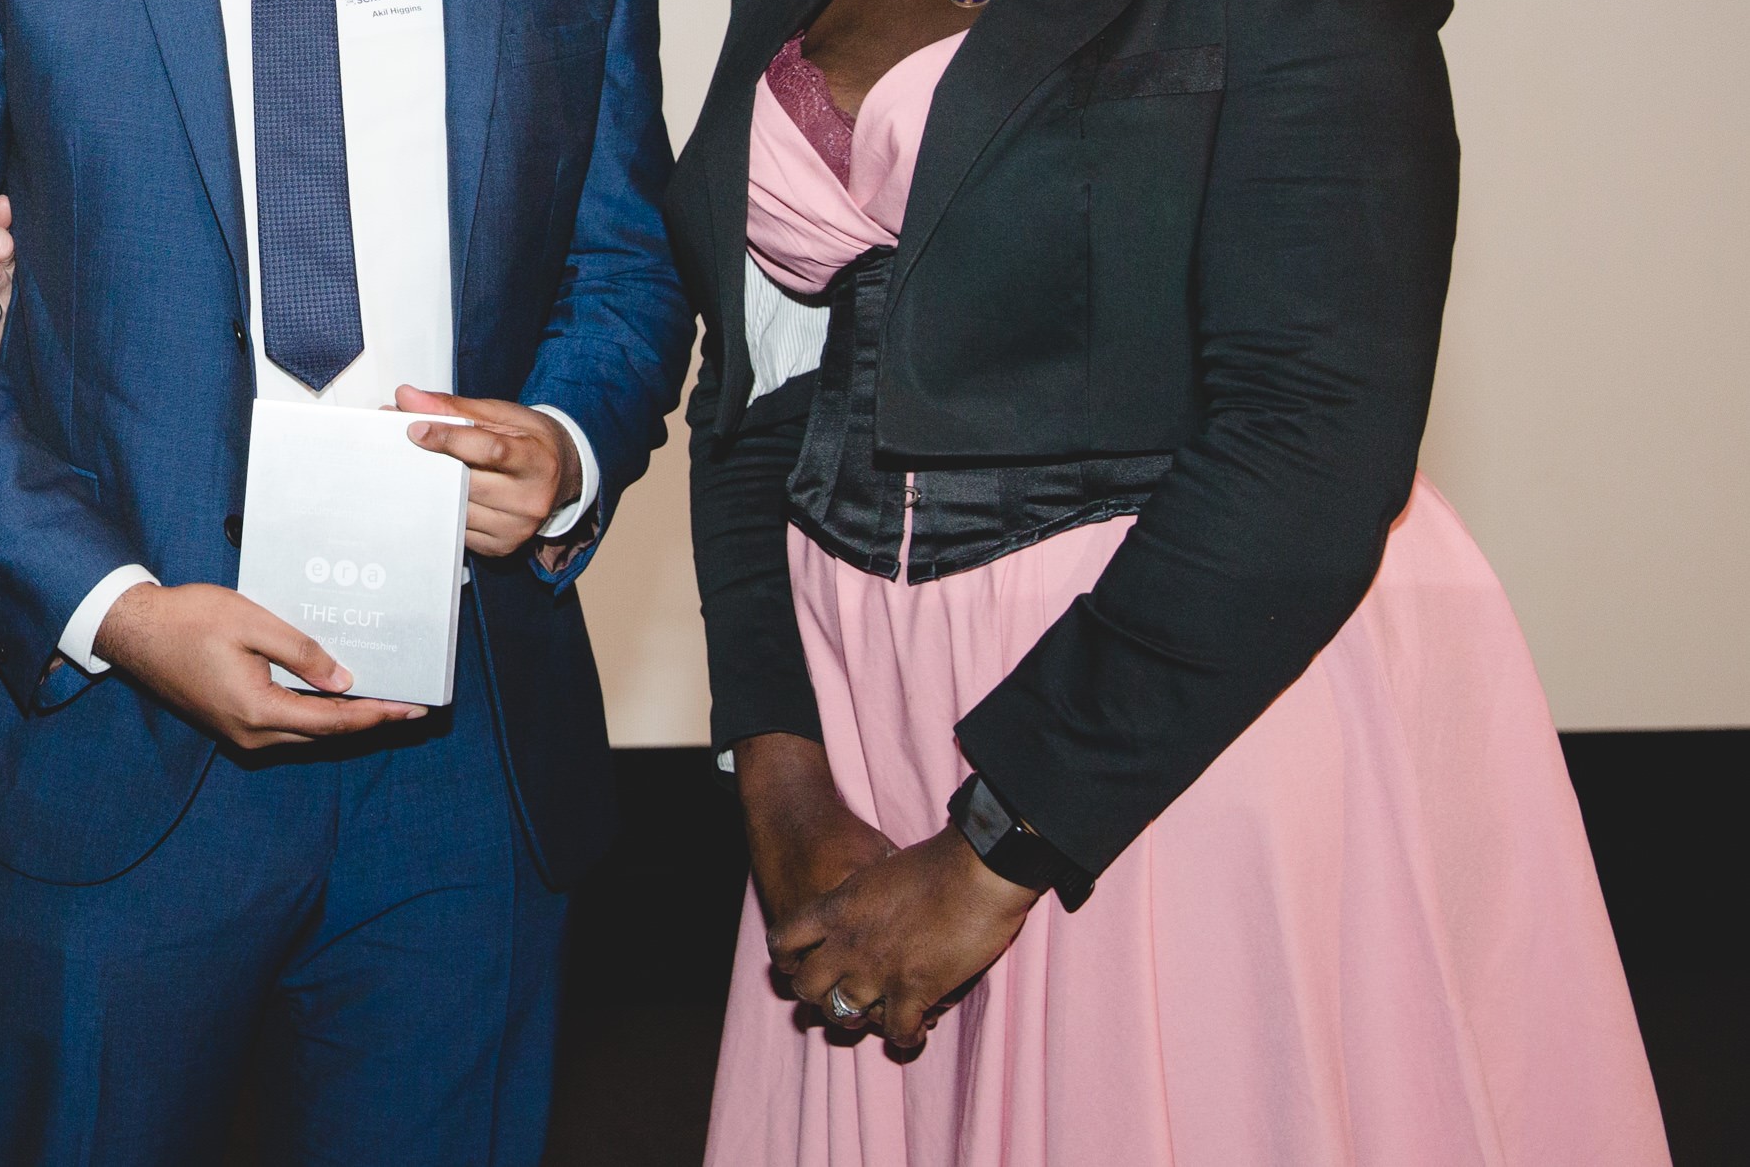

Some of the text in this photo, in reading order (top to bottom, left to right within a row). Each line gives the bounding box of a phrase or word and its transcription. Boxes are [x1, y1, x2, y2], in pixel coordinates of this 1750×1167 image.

[372, 5, 422, 17] Akil Higgins
[300, 603, 384, 628] THE CUT
[328, 635, 338, 645] of
[340, 637, 398, 652] Bedfordshire
